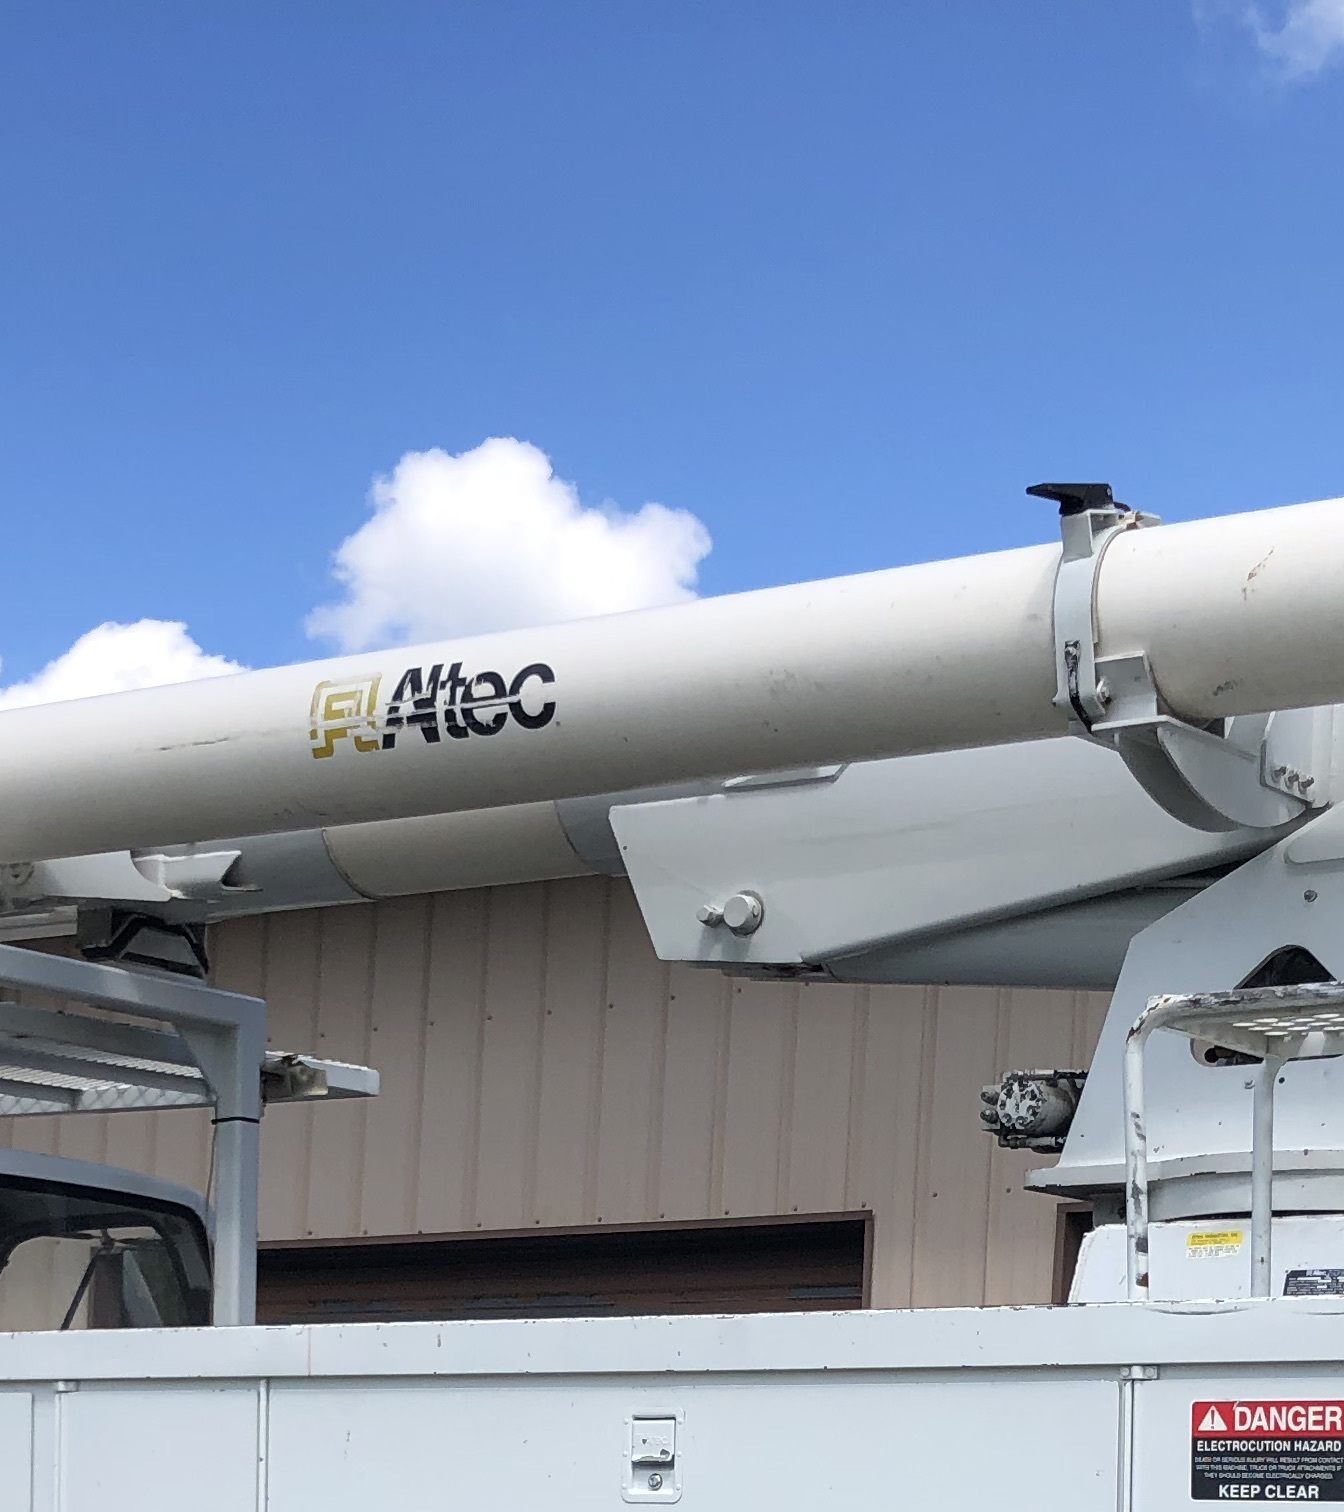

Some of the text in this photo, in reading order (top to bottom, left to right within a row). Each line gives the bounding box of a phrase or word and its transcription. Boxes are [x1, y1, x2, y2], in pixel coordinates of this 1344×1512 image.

[382, 661, 556, 750] Altec
[1234, 1405, 1343, 1432] DANGER
[1196, 1440, 1342, 1452] ELECTROCUTION HAZARD
[1218, 1485, 1319, 1499] KEEP CLEAR
